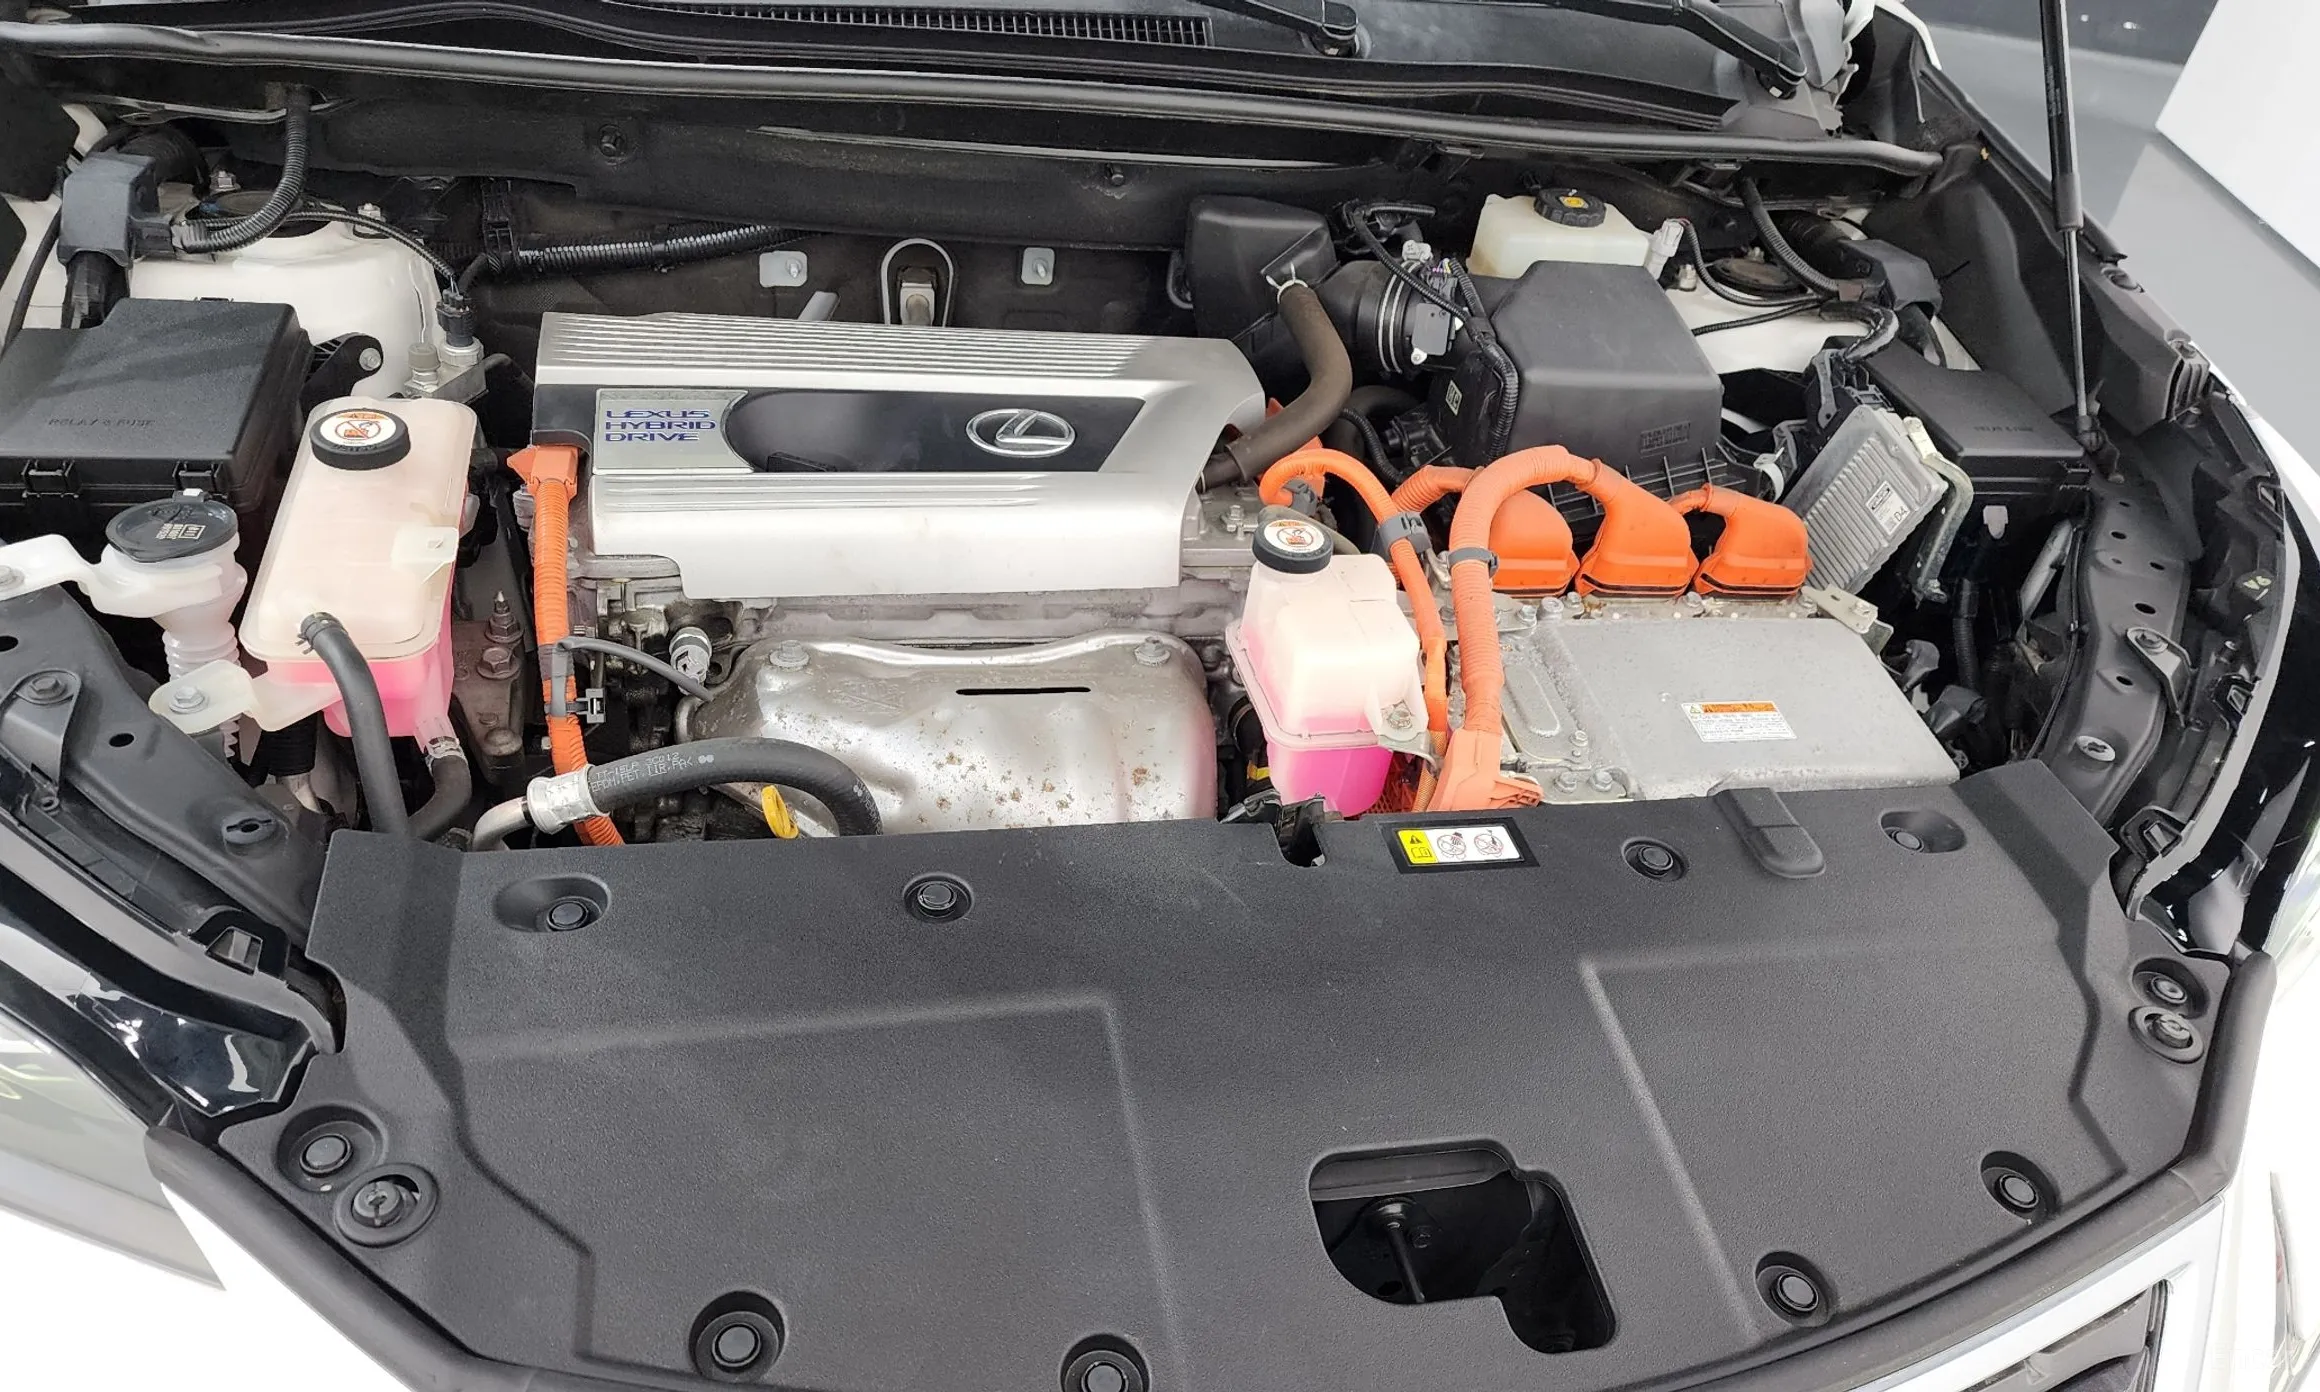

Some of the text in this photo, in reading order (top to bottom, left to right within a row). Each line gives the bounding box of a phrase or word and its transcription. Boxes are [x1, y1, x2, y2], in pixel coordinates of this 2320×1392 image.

[606, 410, 710, 419] LEXUS
[605, 421, 716, 430] HYBRID
[605, 433, 700, 442] DRIVE
